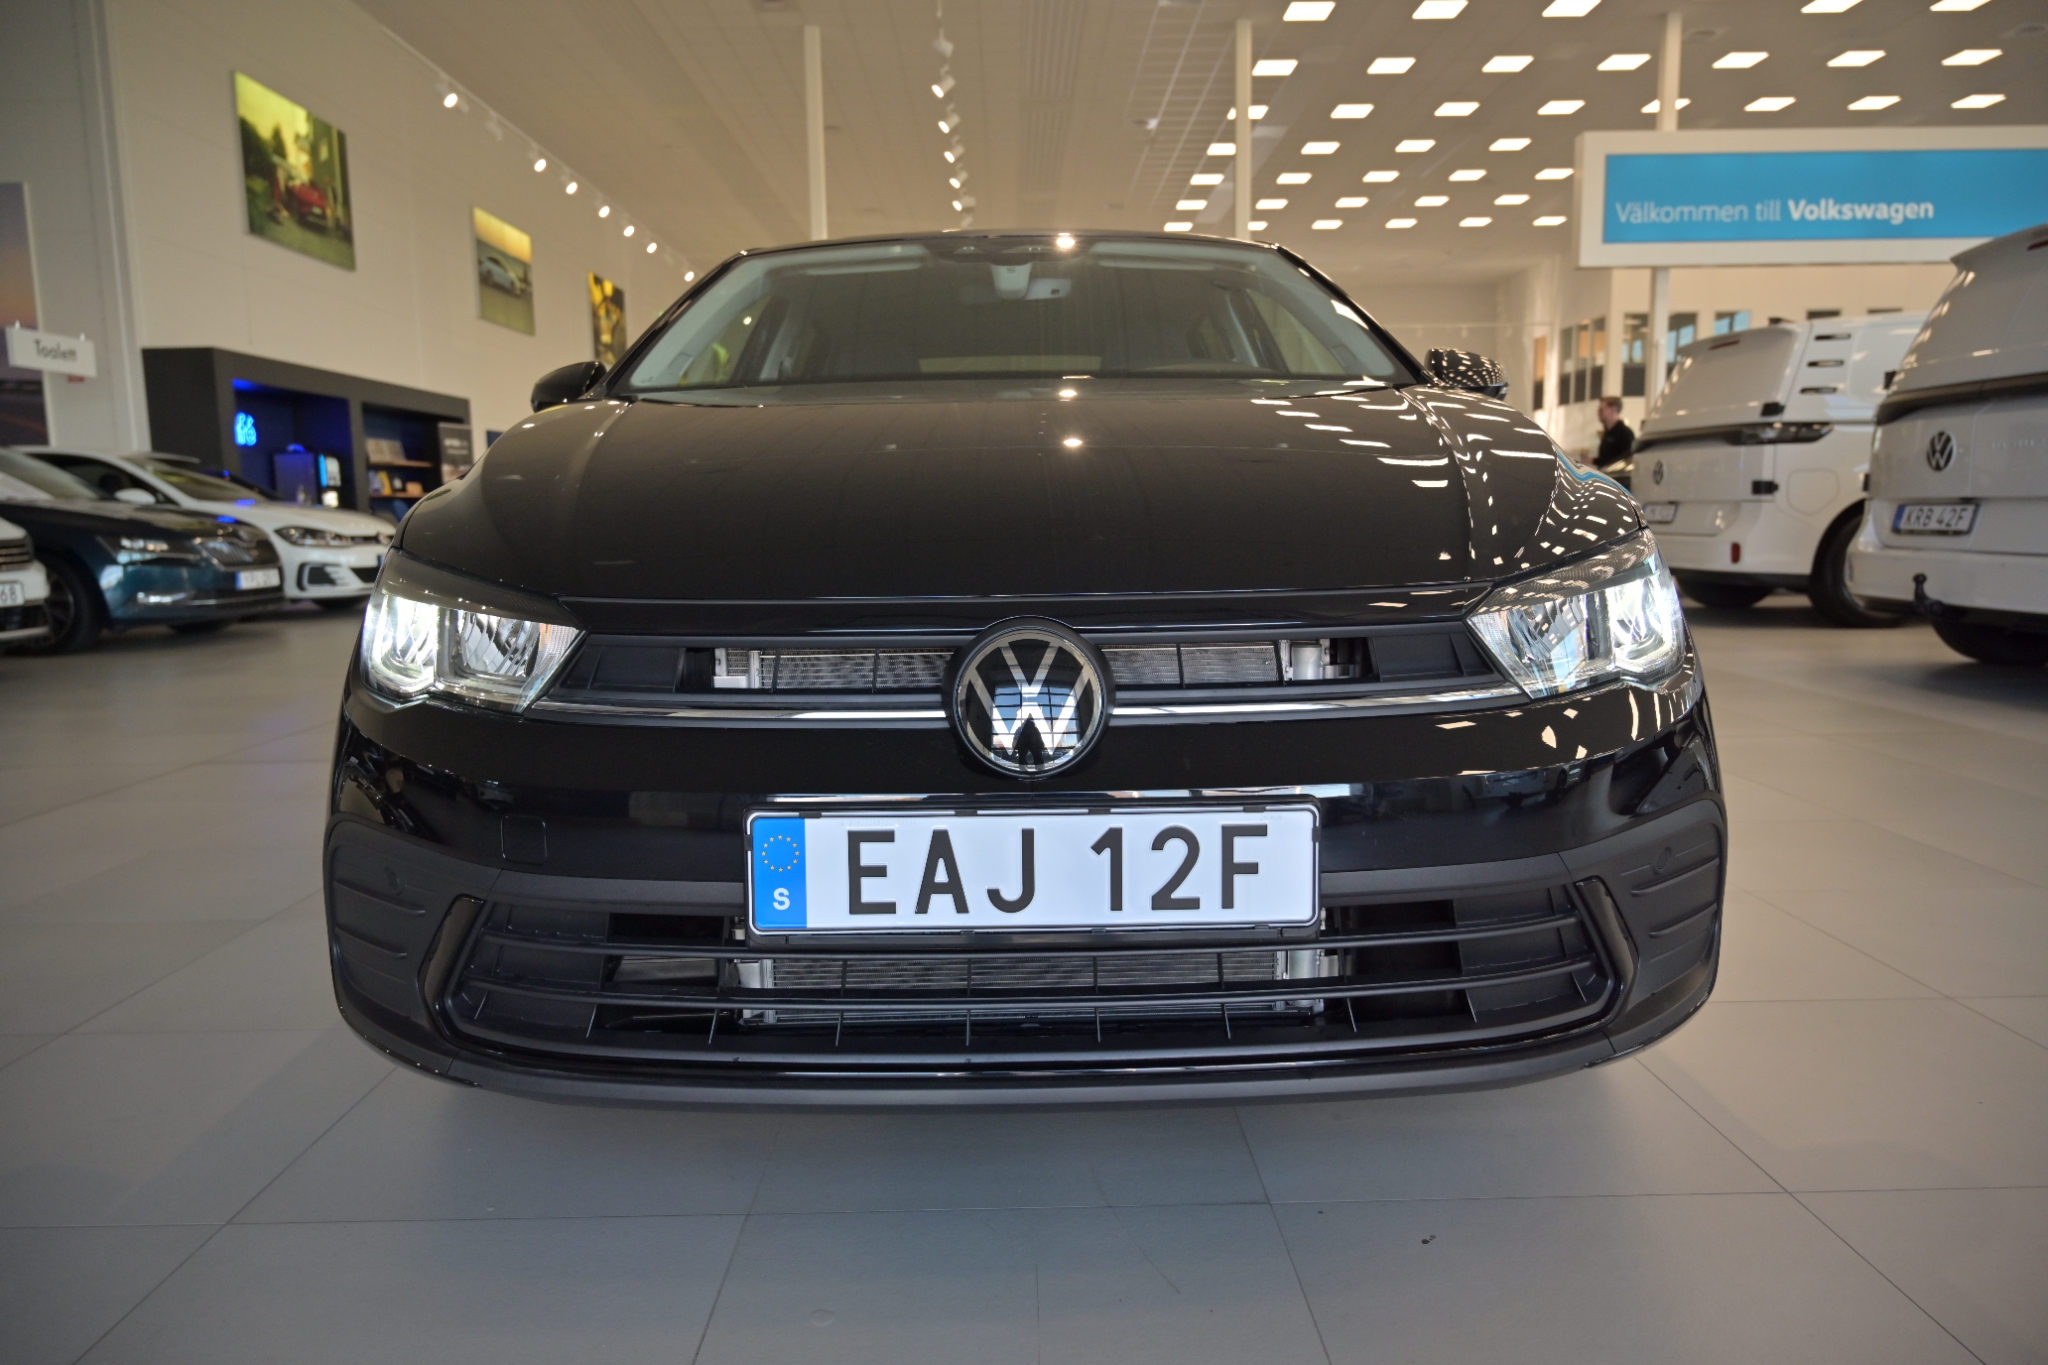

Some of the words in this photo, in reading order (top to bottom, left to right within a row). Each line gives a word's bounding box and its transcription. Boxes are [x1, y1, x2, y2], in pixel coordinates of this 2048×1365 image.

[1615, 201, 1749, 223] Välkommen
[1755, 199, 1781, 222] till
[1787, 197, 1935, 225] Volkswagen
[1904, 507, 1935, 527] KRB
[1936, 507, 1968, 527] 42F
[848, 828, 1036, 914] EAJ
[1090, 823, 1268, 911] 12F
[773, 888, 790, 911] S
